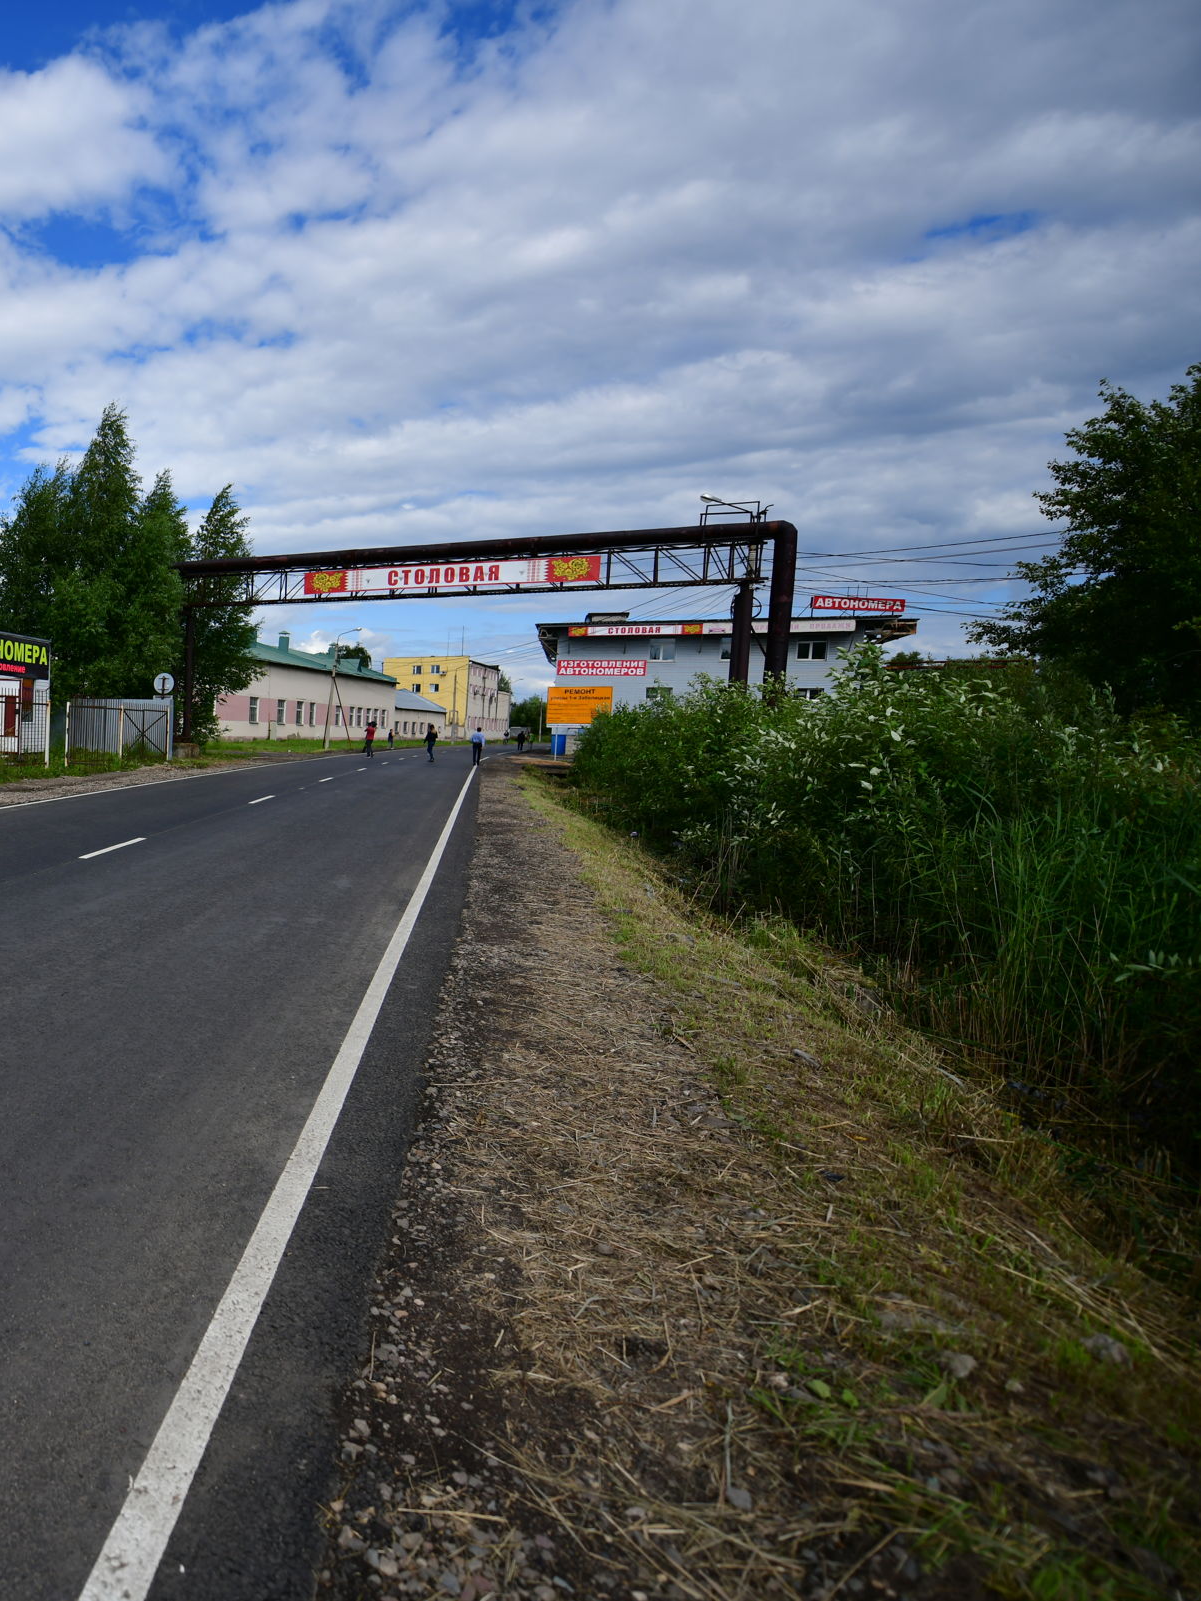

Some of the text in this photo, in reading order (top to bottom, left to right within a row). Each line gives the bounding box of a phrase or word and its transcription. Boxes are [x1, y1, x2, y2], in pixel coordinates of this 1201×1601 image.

[387, 565, 500, 586] СТОЛОВАЯ
[815, 597, 902, 610] АВТОНОМЕРА
[607, 626, 661, 635] СТОЛОВАЯ
[559, 668, 645, 676] АВТОНОМЕРОВ
